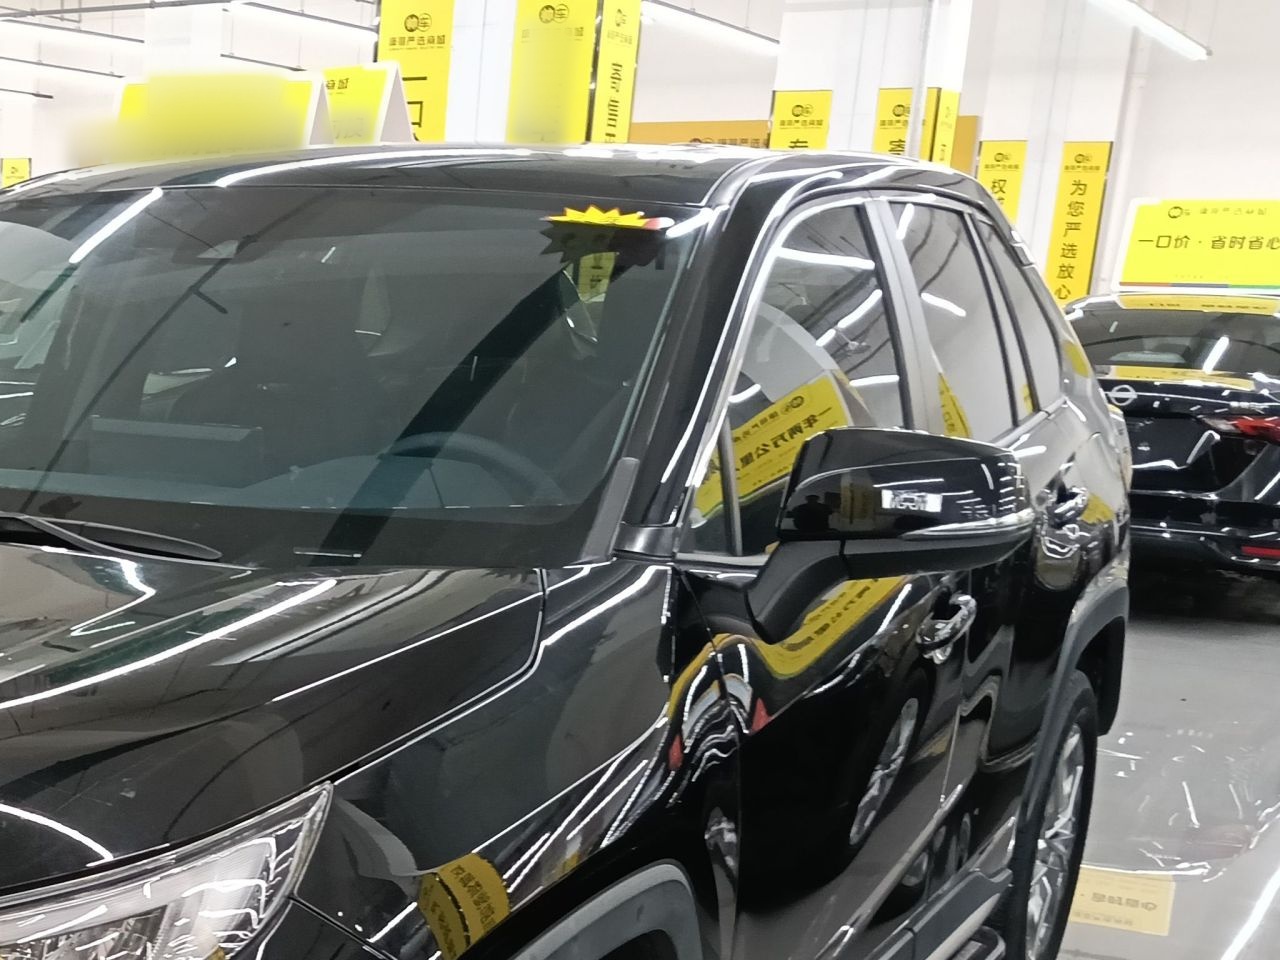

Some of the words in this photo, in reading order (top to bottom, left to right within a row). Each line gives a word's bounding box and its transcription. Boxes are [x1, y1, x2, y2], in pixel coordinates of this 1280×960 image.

[1053, 179, 1088, 300] 为您严选放心
